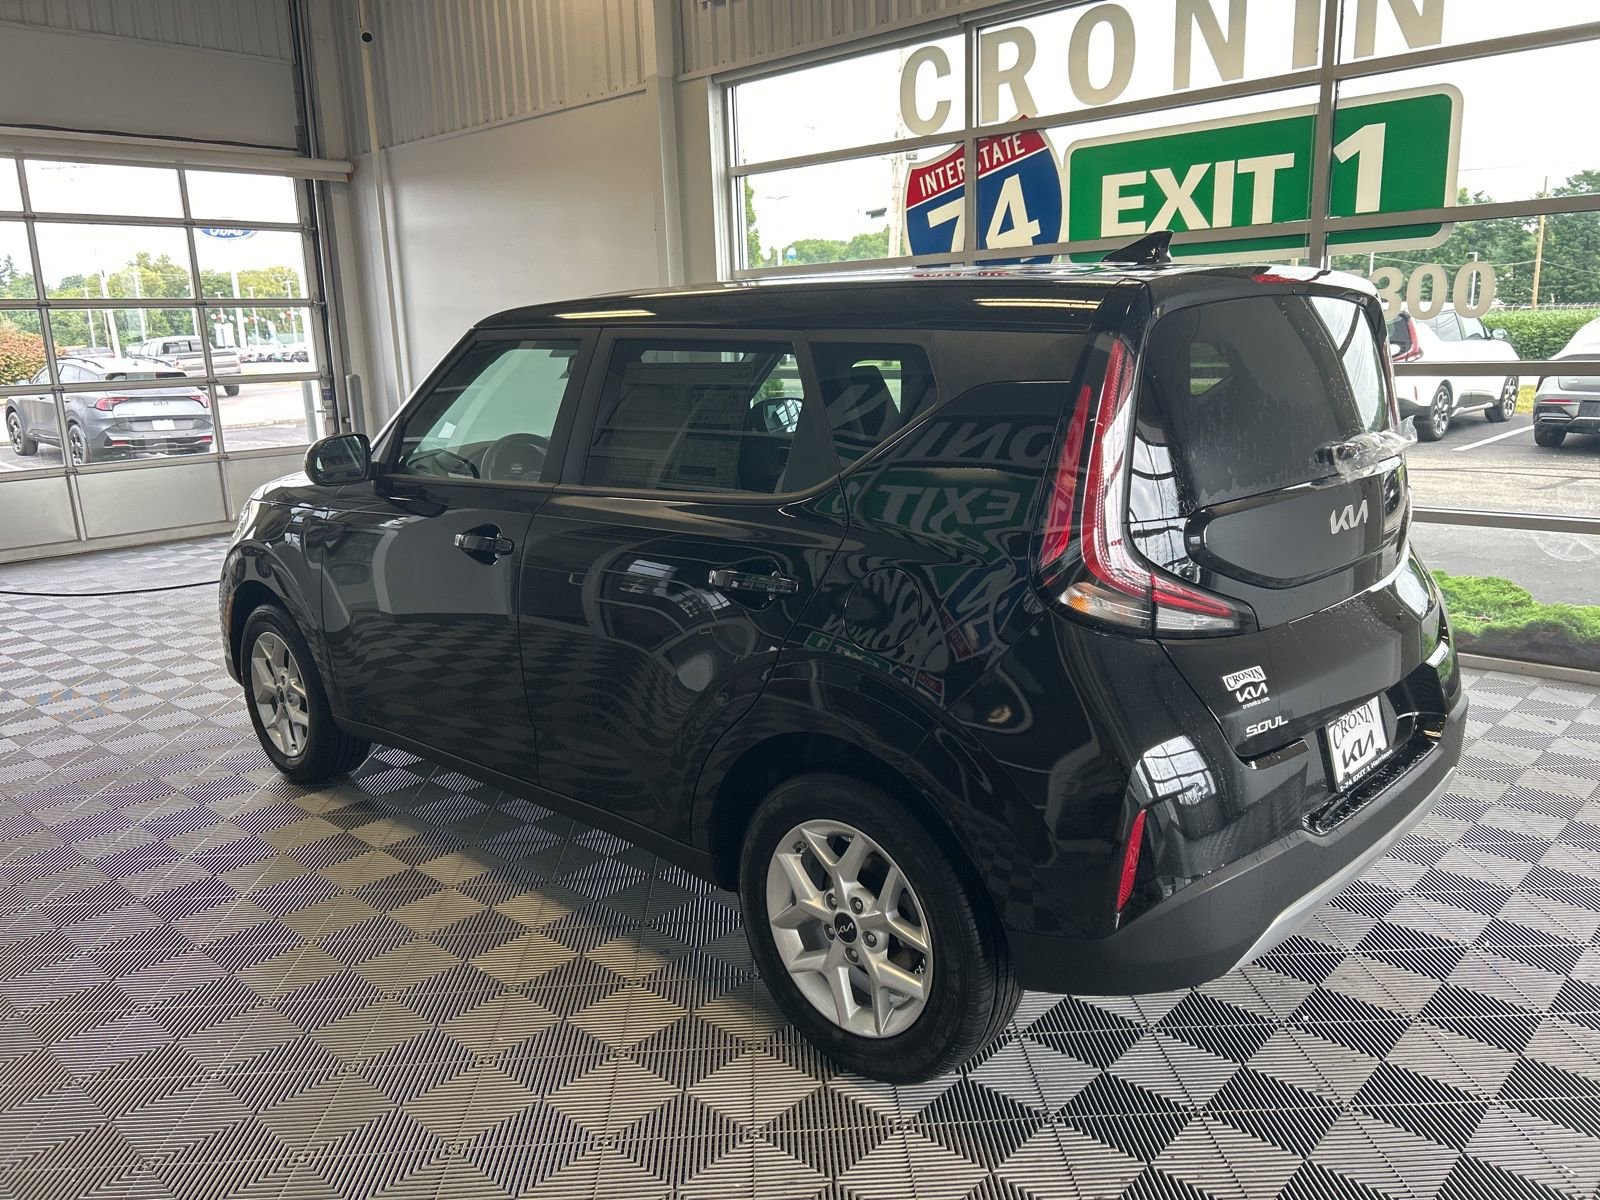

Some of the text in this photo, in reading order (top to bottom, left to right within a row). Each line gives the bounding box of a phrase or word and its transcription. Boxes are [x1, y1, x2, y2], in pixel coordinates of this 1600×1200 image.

[919, 132, 1026, 198] INTERTATE
[1101, 122, 1386, 238] EXIT 1
[927, 173, 1041, 263] 74
[1344, 261, 1496, 321] 300
[1330, 500, 1368, 535] KIA
[1225, 667, 1264, 689] CRONIN
[1235, 682, 1268, 703] KIA
[1245, 715, 1289, 738] SOUL
[1333, 703, 1376, 750] CRONIN
[1341, 728, 1375, 770] KIA
